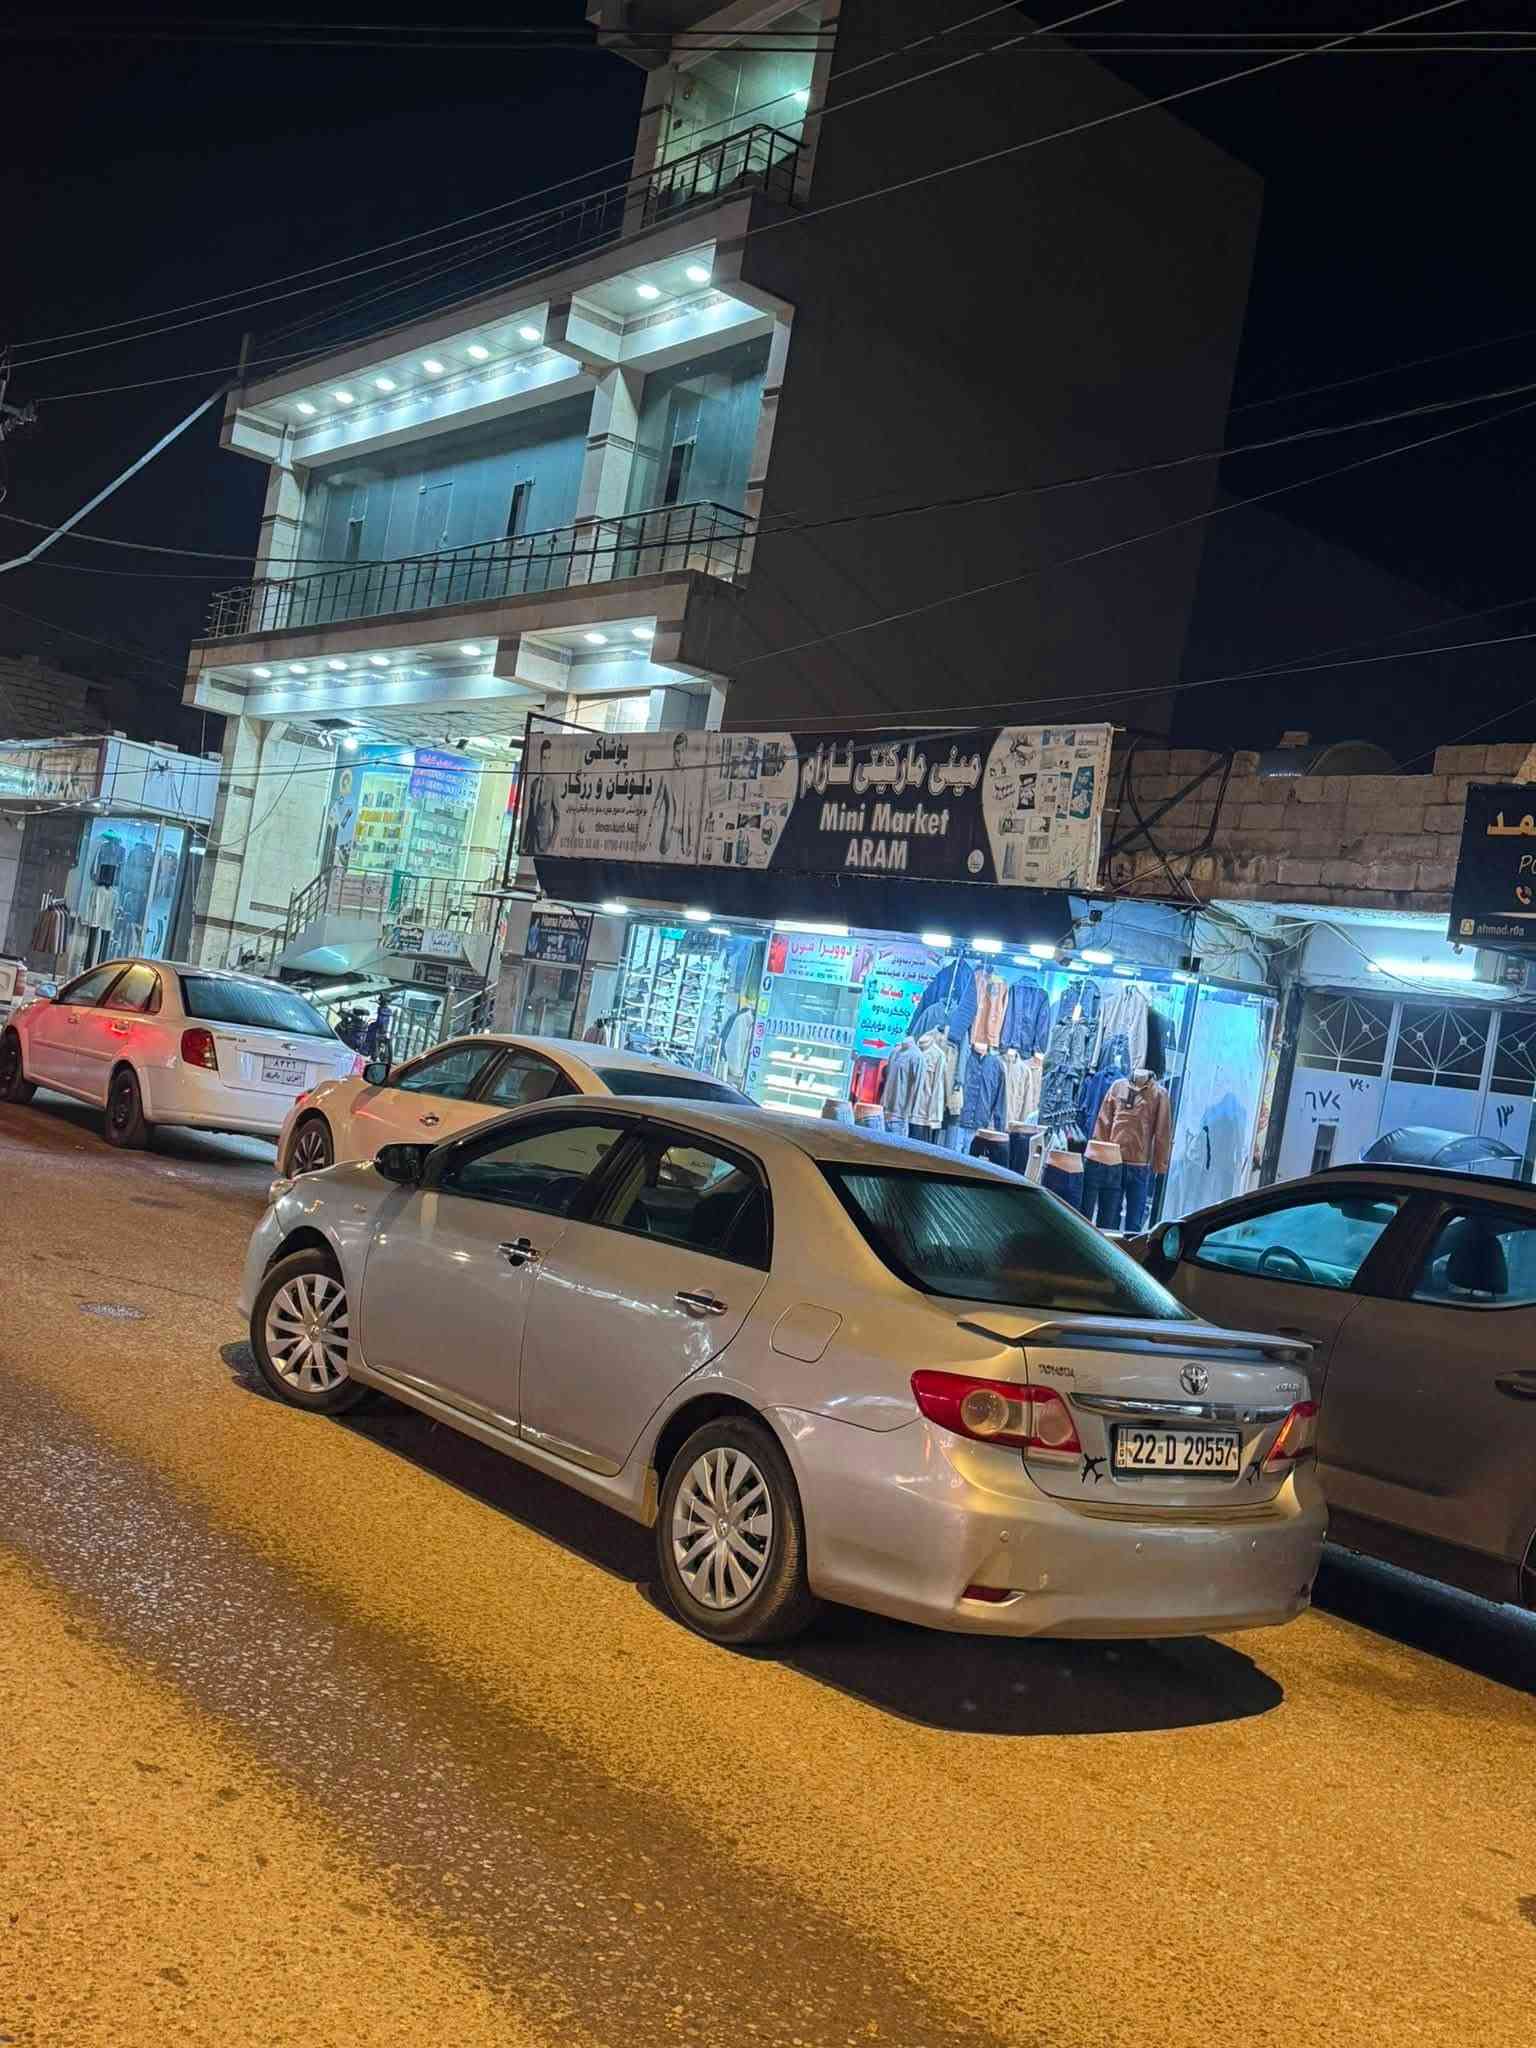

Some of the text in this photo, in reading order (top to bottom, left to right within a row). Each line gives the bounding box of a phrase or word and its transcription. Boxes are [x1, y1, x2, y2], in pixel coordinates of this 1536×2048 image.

[819, 803, 950, 835] Mini Market
[845, 839, 908, 870] ARAM
[1133, 1433, 1234, 1467] 22 D 29557
